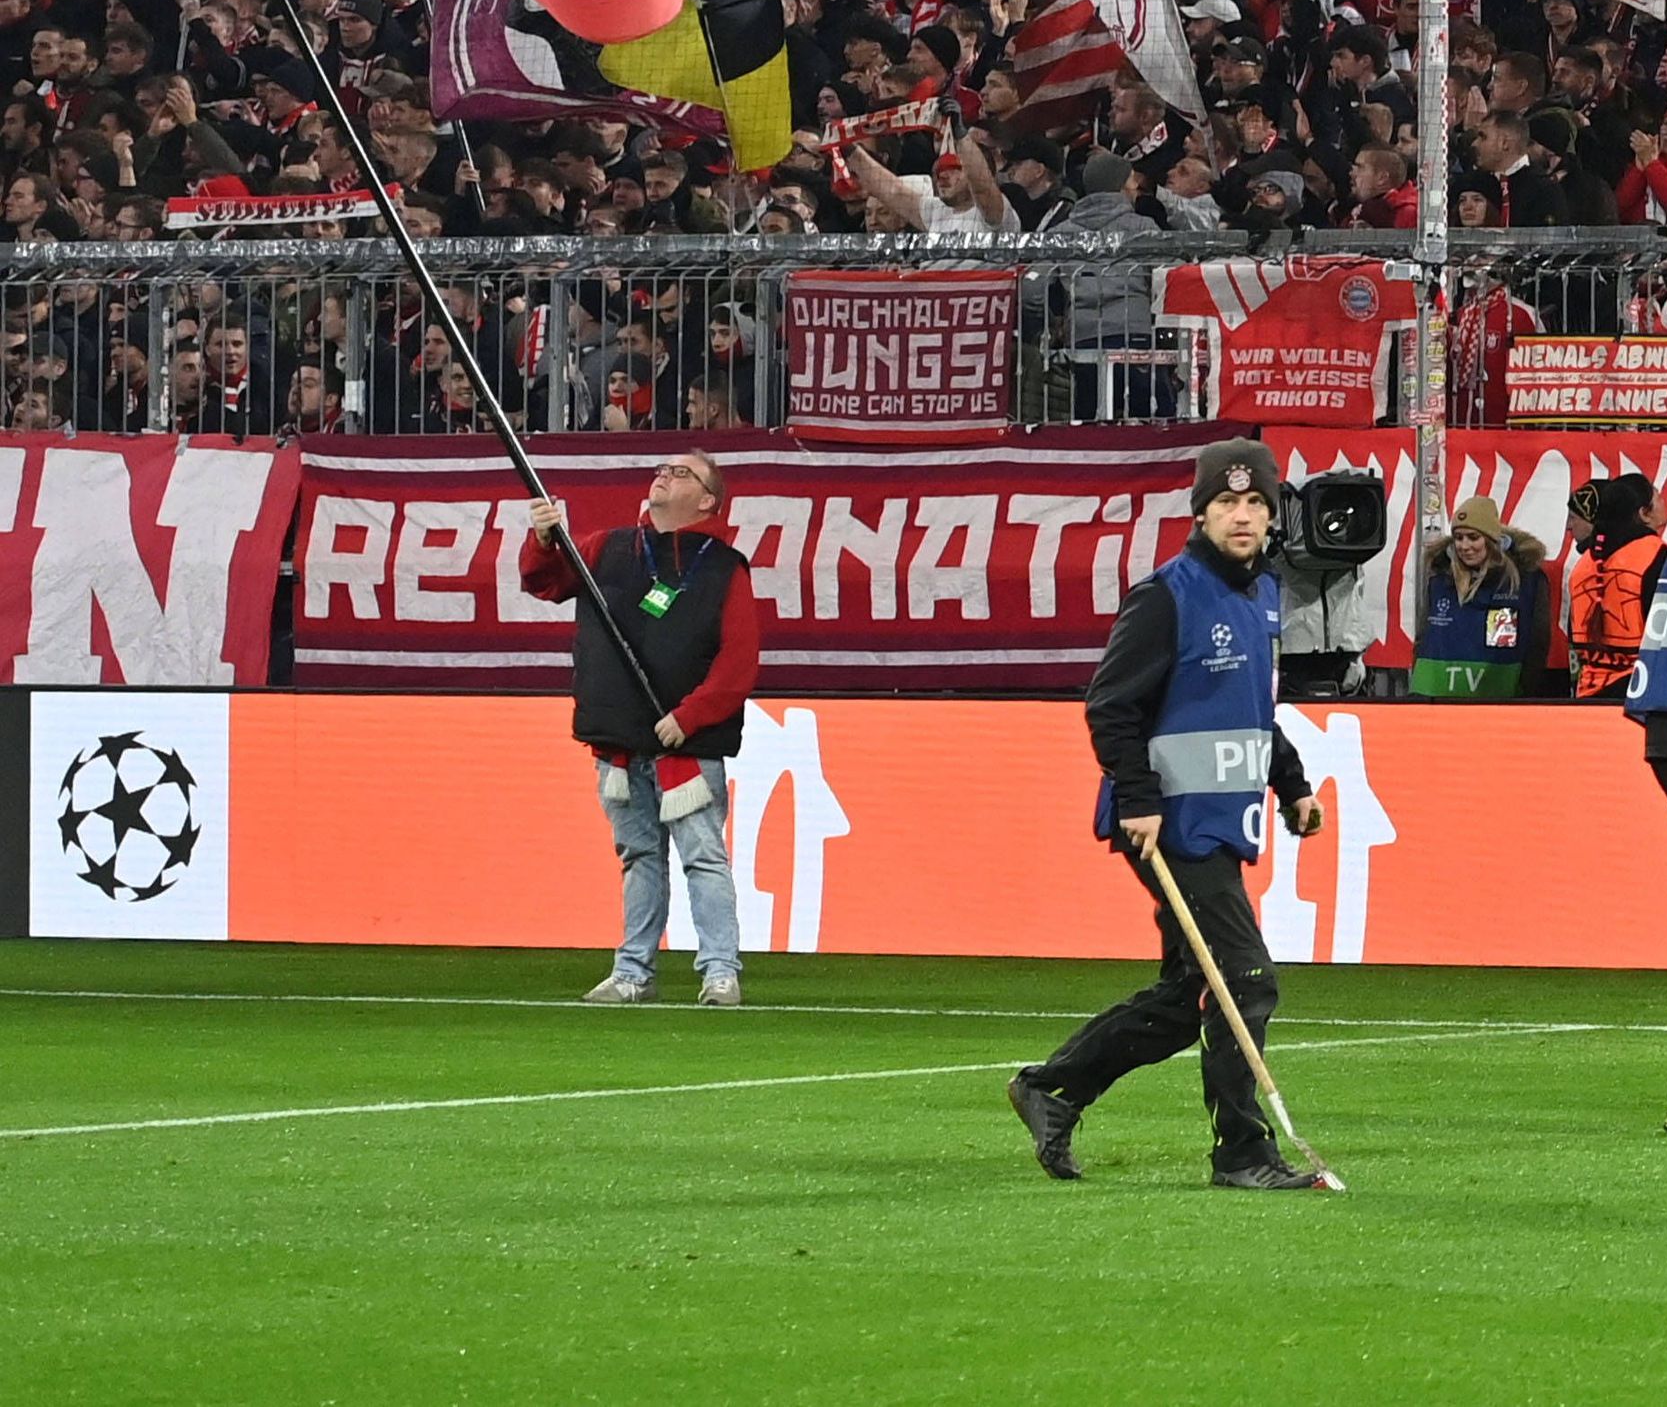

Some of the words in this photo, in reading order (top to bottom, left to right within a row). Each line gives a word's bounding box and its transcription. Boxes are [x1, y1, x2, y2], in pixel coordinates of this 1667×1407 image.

[790, 330, 1006, 392] JUNGS!
[1230, 348, 1274, 366] WIR
[1280, 348, 1372, 367] WOLLEN
[1508, 344, 1608, 370] NIEMALS
[1232, 370, 1371, 389] ROT-WEISSE
[789, 392, 814, 412] NO
[867, 395, 905, 415] CAN
[911, 394, 964, 415] STOP
[970, 392, 998, 413] US
[1255, 390, 1346, 409] TRIKOTS
[1508, 388, 1593, 413] IMMER
[1445, 666, 1485, 692] TV
